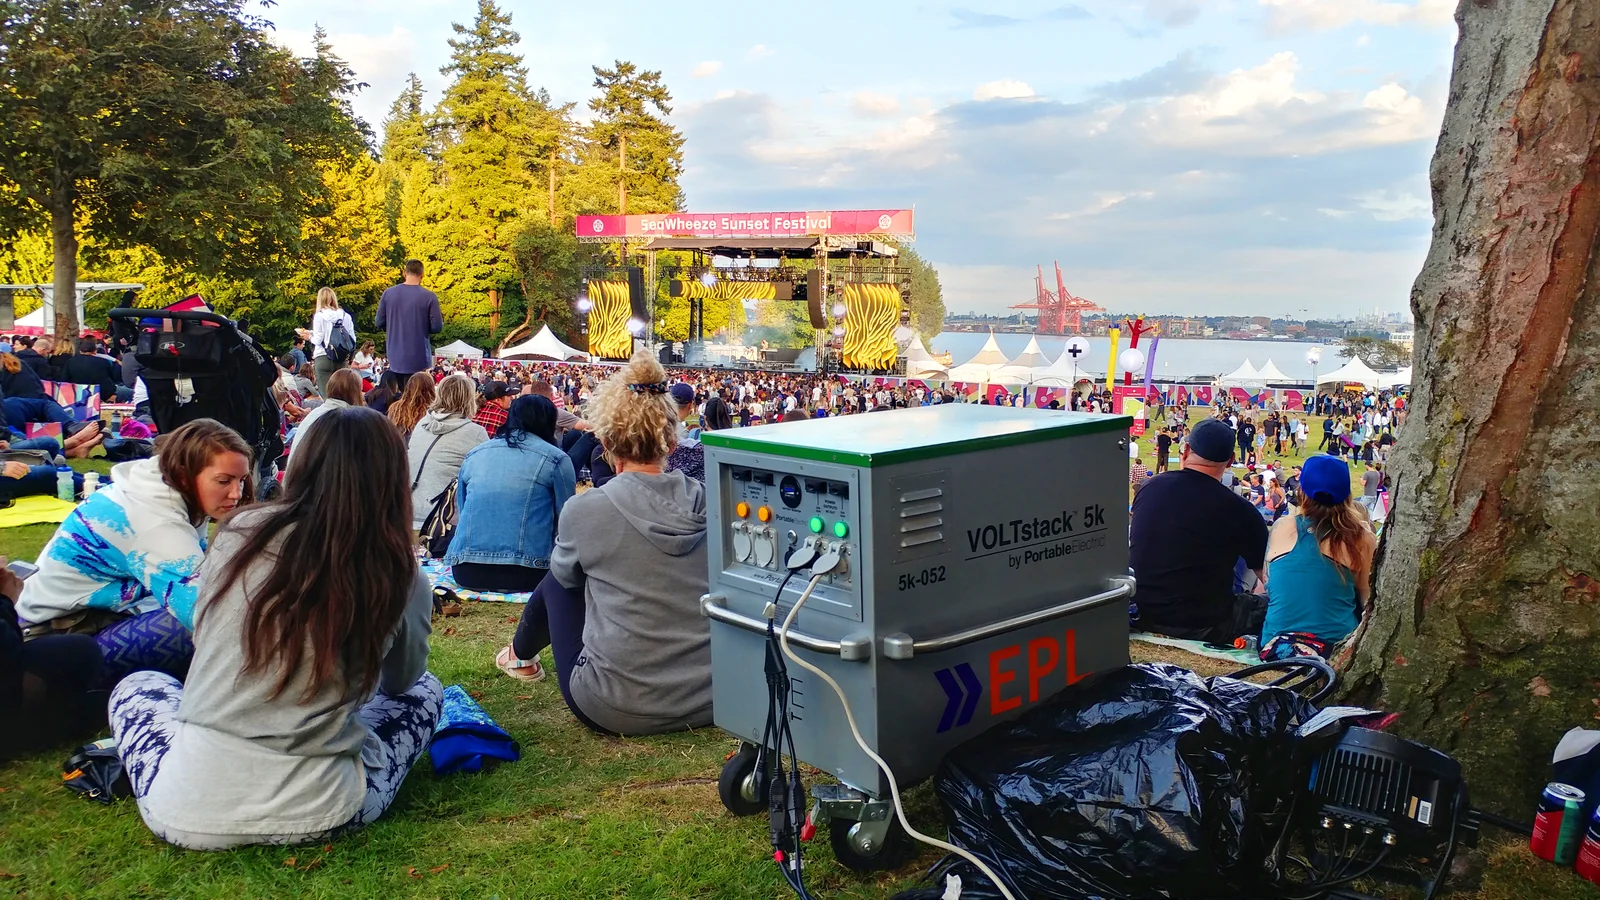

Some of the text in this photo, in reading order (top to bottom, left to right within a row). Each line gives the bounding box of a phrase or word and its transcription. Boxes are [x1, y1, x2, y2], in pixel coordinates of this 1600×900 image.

[640, 215, 832, 232] SeaWheeze Sunset Festival
[1083, 503, 1105, 529] 5k
[1008, 535, 1107, 570] by PortableElectric
[898, 565, 946, 592] 5k-052
[988, 628, 1094, 717] EPL
